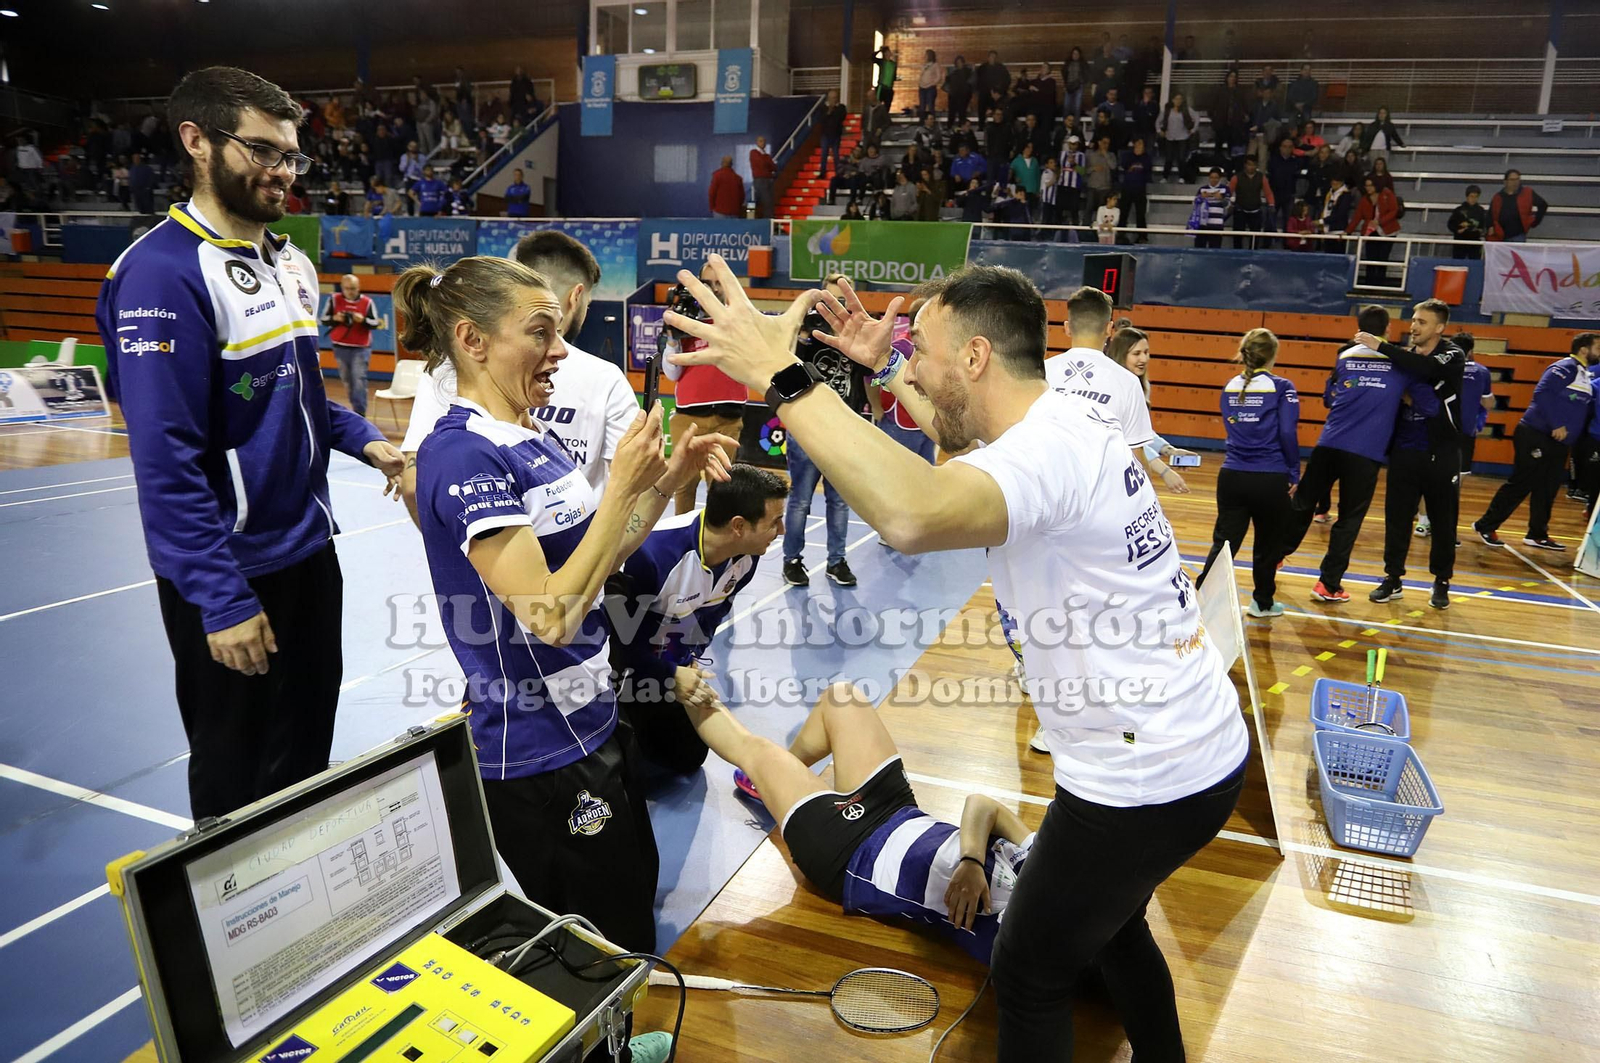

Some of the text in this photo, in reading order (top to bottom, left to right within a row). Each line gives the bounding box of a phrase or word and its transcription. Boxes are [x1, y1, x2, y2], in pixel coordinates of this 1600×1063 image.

[407, 228, 469, 241] DIPUTACIÓN
[682, 231, 762, 246] DIPUTACIÓN
[408, 242, 464, 254] DE HUELVA
[682, 248, 698, 260] DE
[818, 260, 946, 281] IBERDROLA
[1102, 268, 1118, 293] 0
[119, 307, 177, 320] Fundación
[244, 300, 276, 317] CEJUDO
[120, 337, 175, 357] Cajasol
[1126, 528, 1162, 563] IES
[309, 800, 372, 840] DEPORTIVA
[226, 883, 302, 927] Instrucciones de Manejo
[228, 906, 279, 941] MDG RS-BAD3
[386, 973, 415, 982] VICTOR
[278, 1047, 312, 1060] VICTOR
